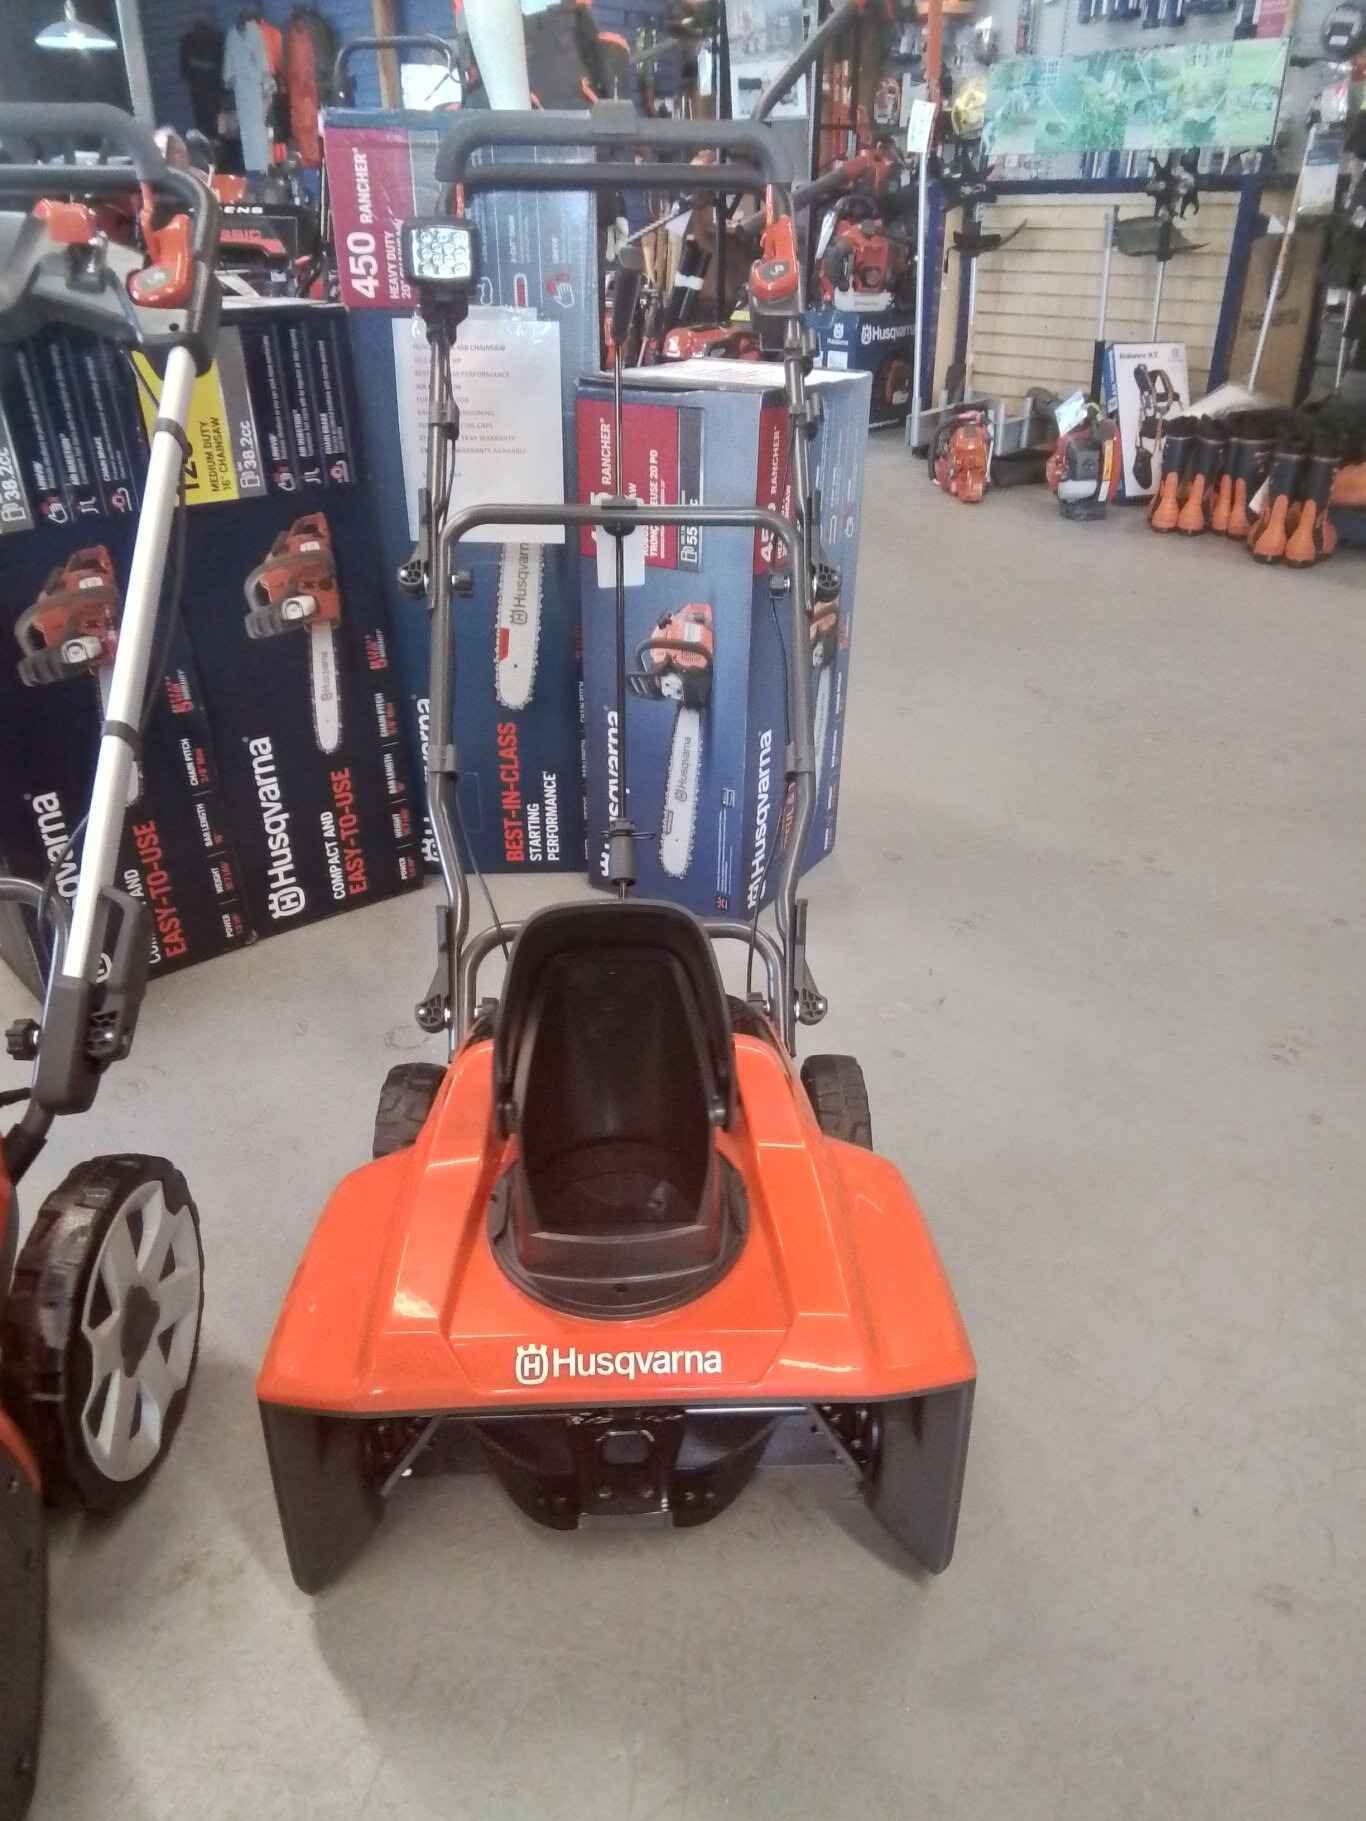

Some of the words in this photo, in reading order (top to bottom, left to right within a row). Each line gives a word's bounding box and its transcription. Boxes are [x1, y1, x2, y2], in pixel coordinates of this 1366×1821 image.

[384, 231, 396, 261] DUTY
[346, 231, 380, 298] 450
[387, 263, 400, 299] HEAVY
[469, 344, 506, 352] CHAINSAW
[872, 324, 916, 341] Husqvarna
[199, 421, 211, 449] DUTY
[209, 417, 229, 473] CHAINSAW
[239, 420, 257, 470] 38.2cc
[204, 451, 220, 492] MEDIUM
[515, 542, 530, 608] Husqvarn
[374, 693, 386, 715] PITCH
[180, 738, 194, 761] PITCH
[676, 736, 692, 790] Husqvarna
[187, 762, 199, 786] CHAIN
[383, 754, 396, 780] LENGTH
[496, 722, 525, 862] BEST-IN-CLASS
[750, 729, 773, 877] Husqvarna
[195, 803, 209, 829] LENGTH
[249, 736, 297, 889] Husqvarna
[320, 810, 338, 839] AND
[202, 829, 214, 847] BAR
[330, 767, 369, 896] EASY-TO-USE
[529, 803, 543, 861] STARTING
[123, 868, 145, 898] AND
[211, 867, 224, 894] WEIGHT
[325, 840, 347, 901] COMPACT
[397, 857, 409, 880] POWER
[132, 820, 187, 958] EASY-TO-USE
[222, 914, 234, 938] POWER
[552, 1347, 723, 1380] Husqvarna
